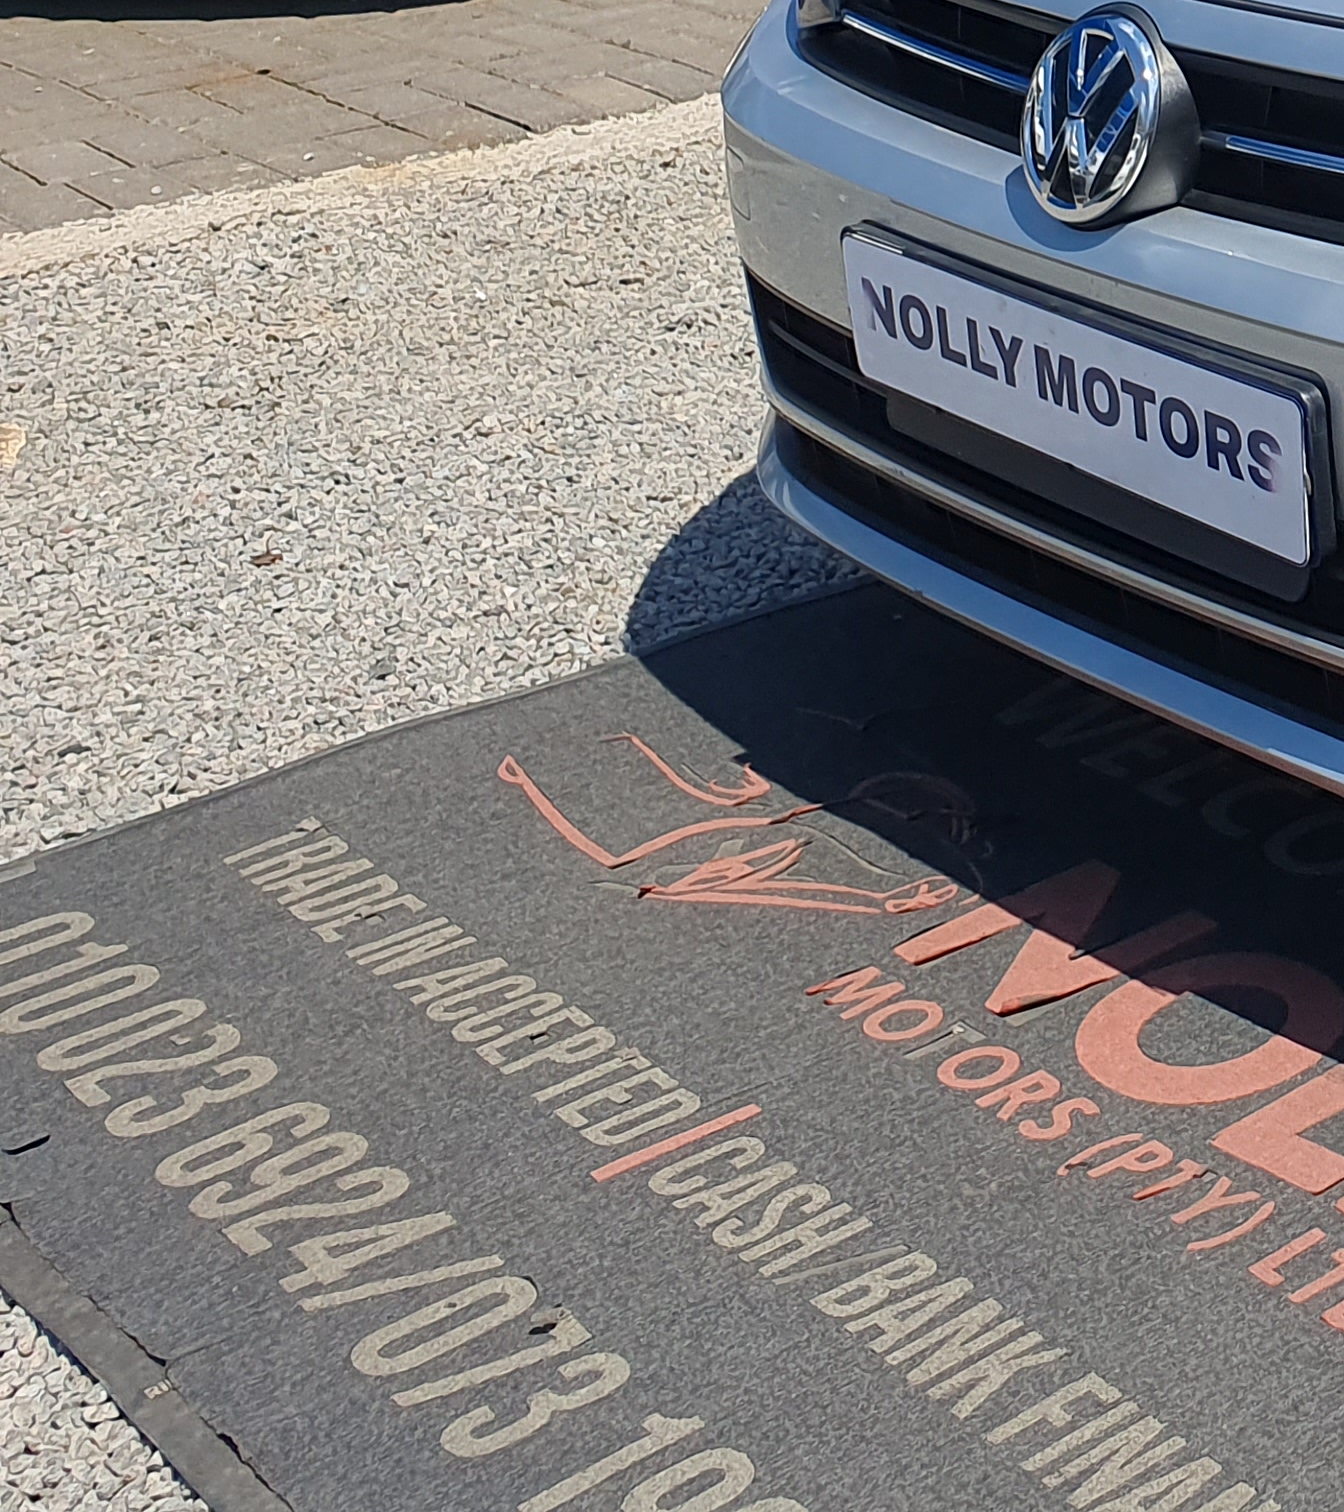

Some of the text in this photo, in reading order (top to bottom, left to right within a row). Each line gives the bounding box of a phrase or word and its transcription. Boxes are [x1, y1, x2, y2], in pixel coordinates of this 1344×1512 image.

[1021, 10, 1160, 225] VW
[861, 276, 1283, 494] NOLLY MOTORS
[222, 816, 428, 943] TRADE
[345, 916, 479, 976] IN
[1056, 1132, 1275, 1252] (PTY)
